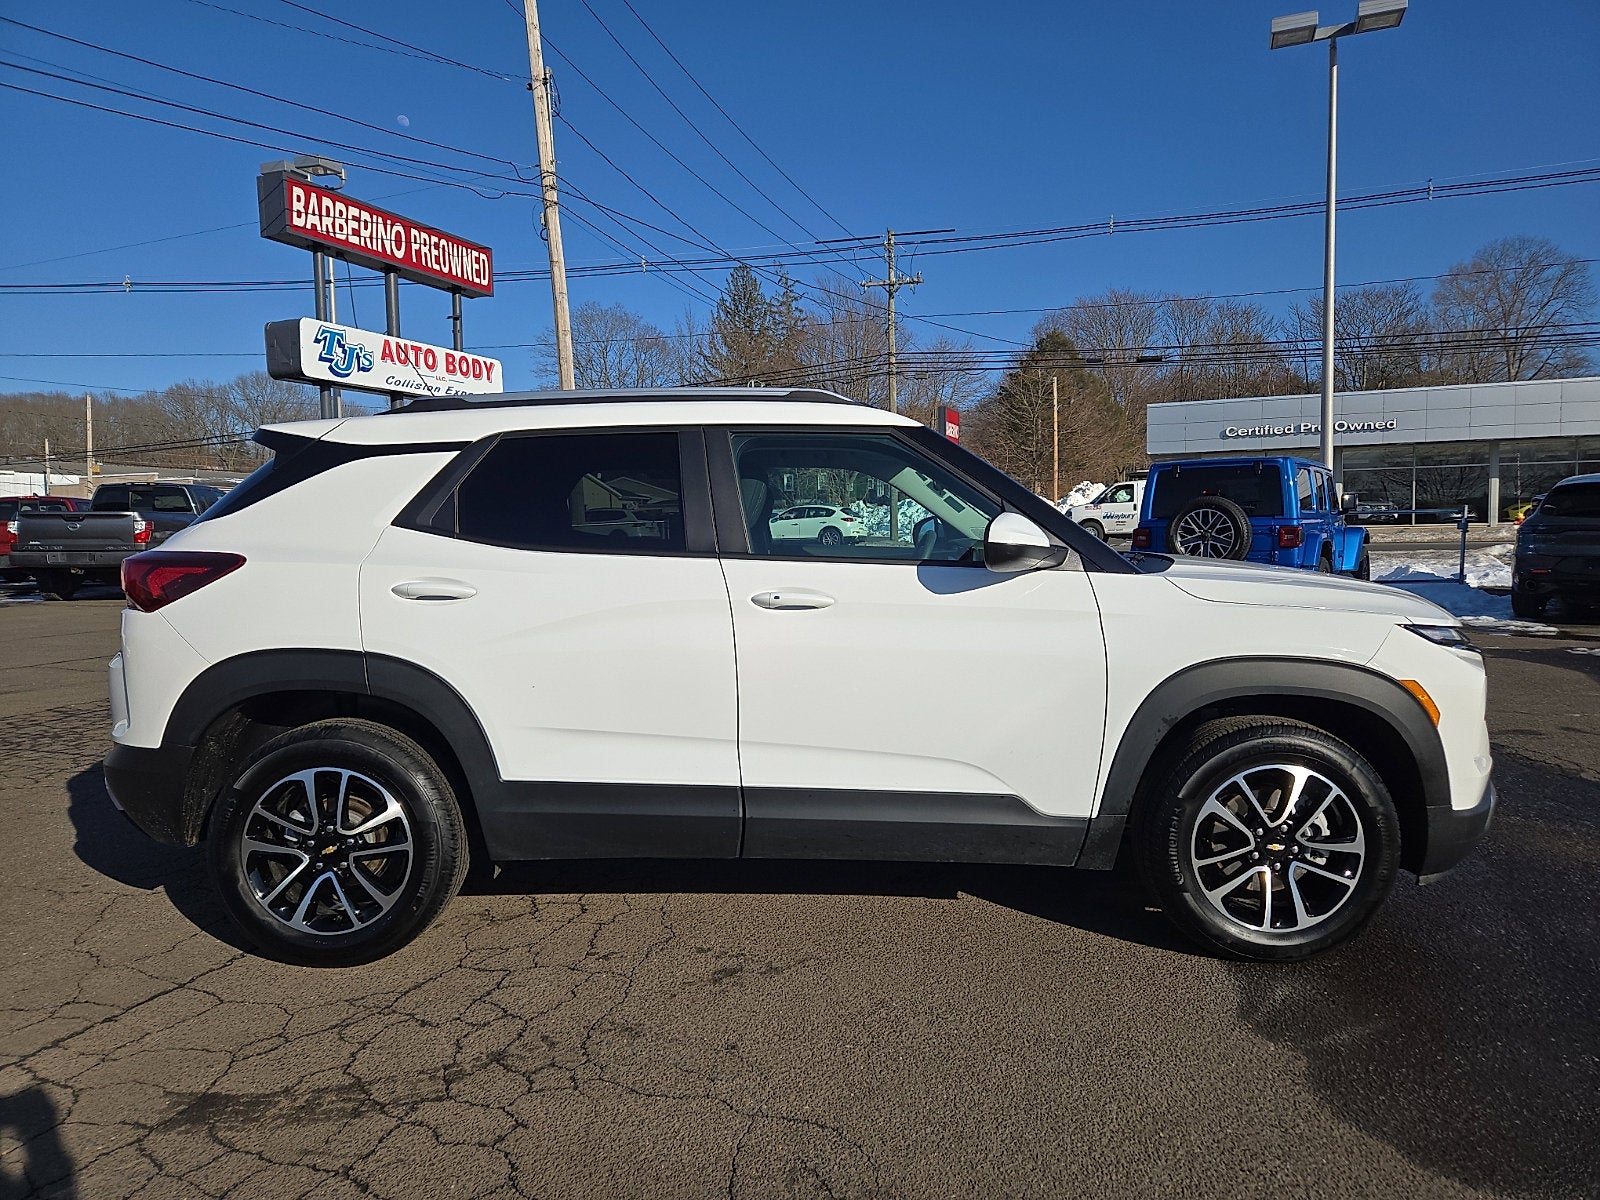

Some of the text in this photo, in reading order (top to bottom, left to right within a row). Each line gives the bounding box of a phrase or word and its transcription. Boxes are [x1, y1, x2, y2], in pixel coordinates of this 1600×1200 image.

[292, 185, 489, 286] BARBERINO PREOWNED
[313, 325, 495, 383] TJ's AUTO BODY
[385, 375, 441, 393] Collision
[1225, 423, 1294, 437] Certified
[1334, 418, 1397, 432] Owned
